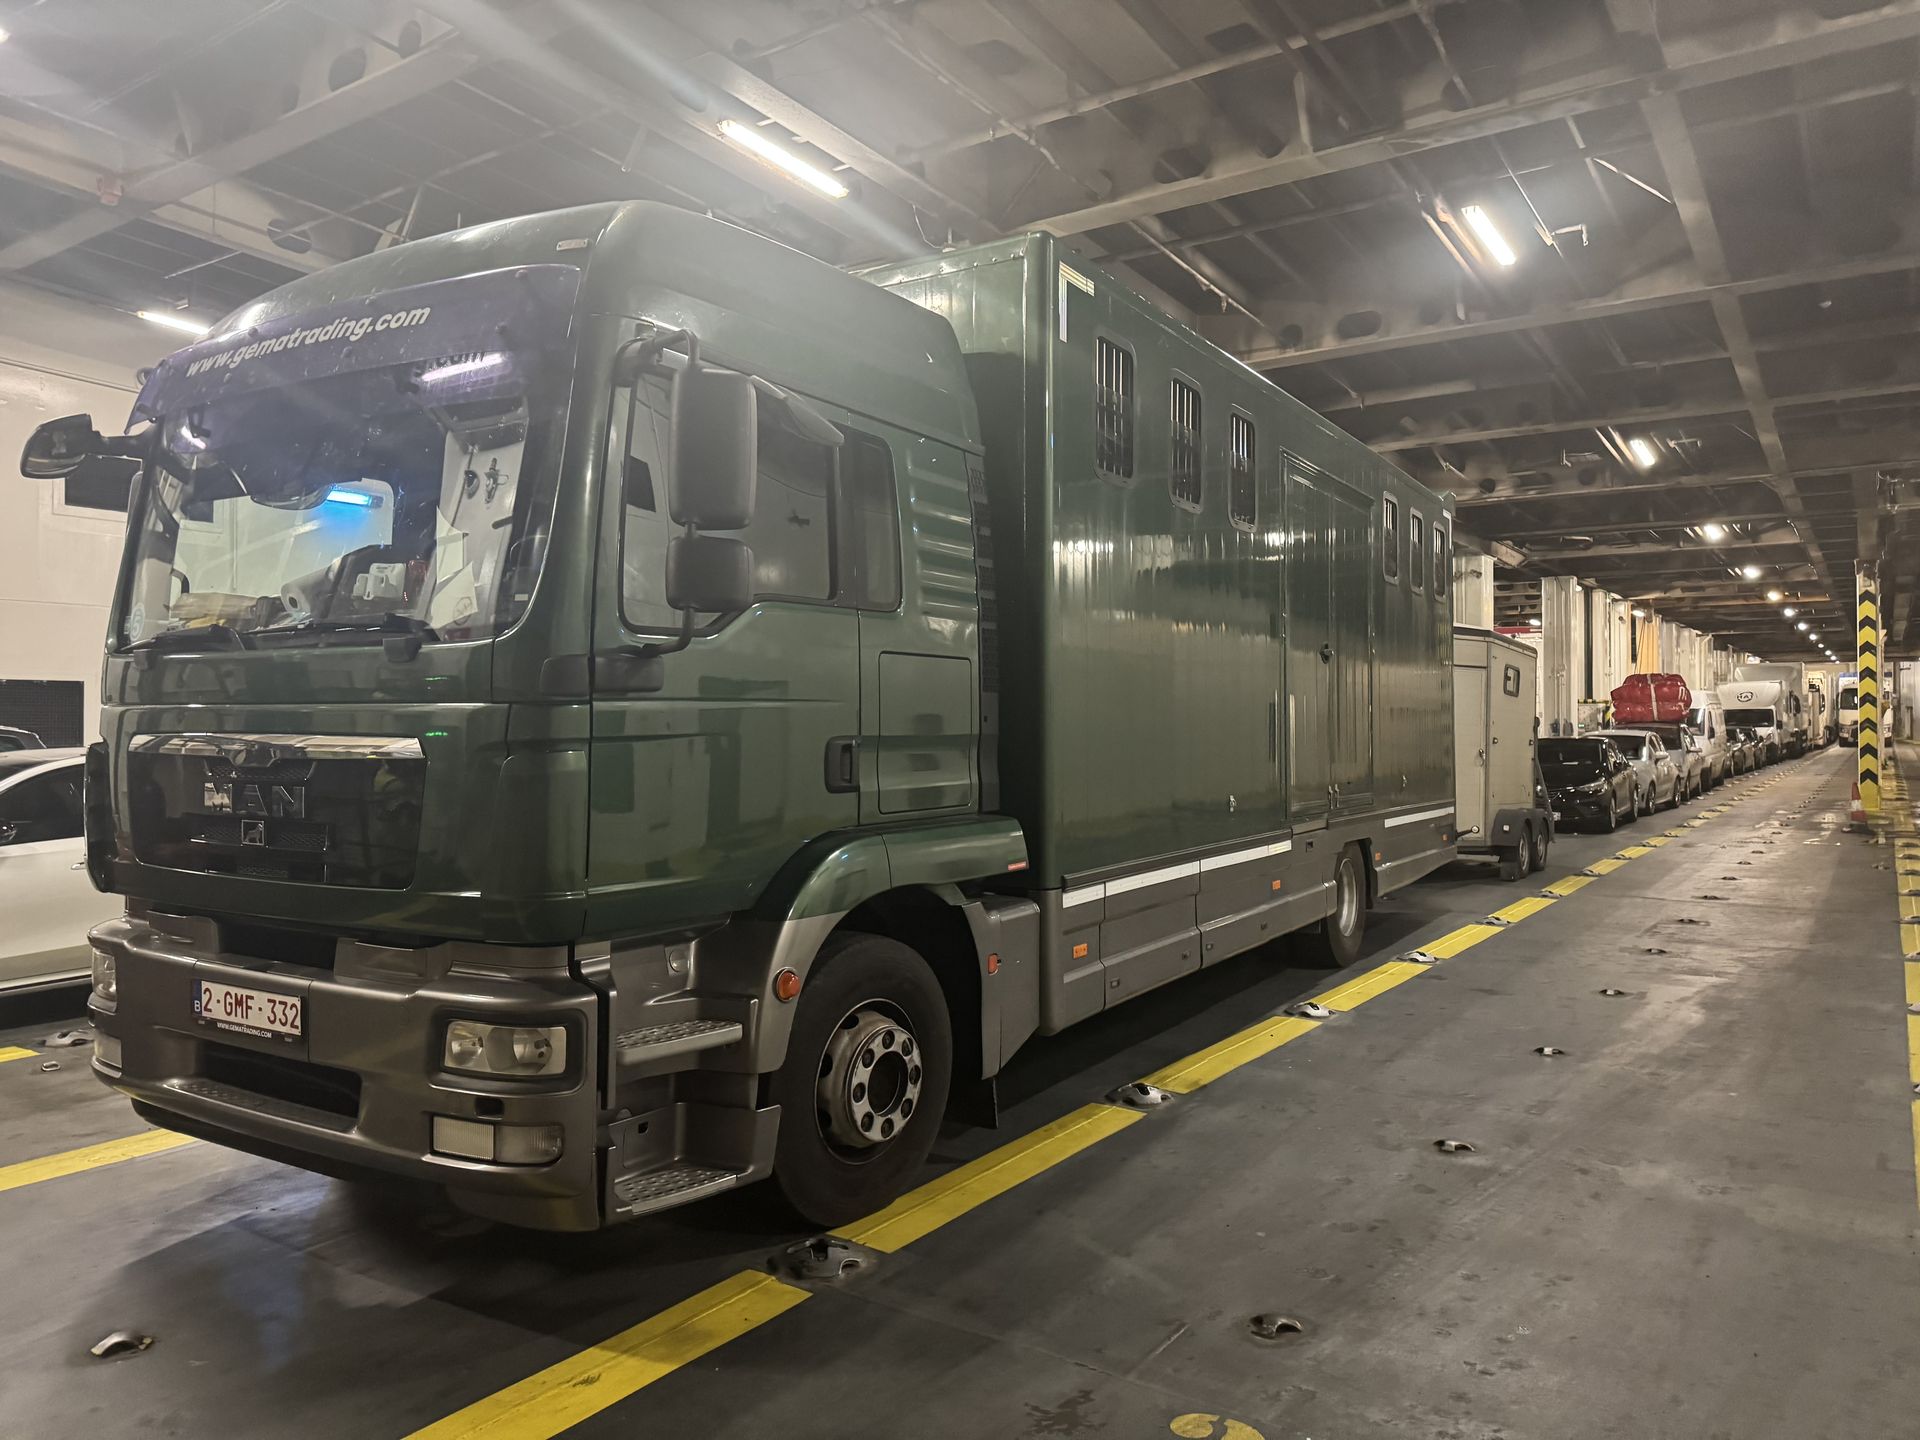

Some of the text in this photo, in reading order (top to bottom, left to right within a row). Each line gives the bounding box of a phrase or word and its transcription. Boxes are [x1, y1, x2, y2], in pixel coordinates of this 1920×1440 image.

[186, 307, 431, 377] www.gematrading.com
[204, 782, 305, 819] MAN
[194, 1000, 201, 1012] B
